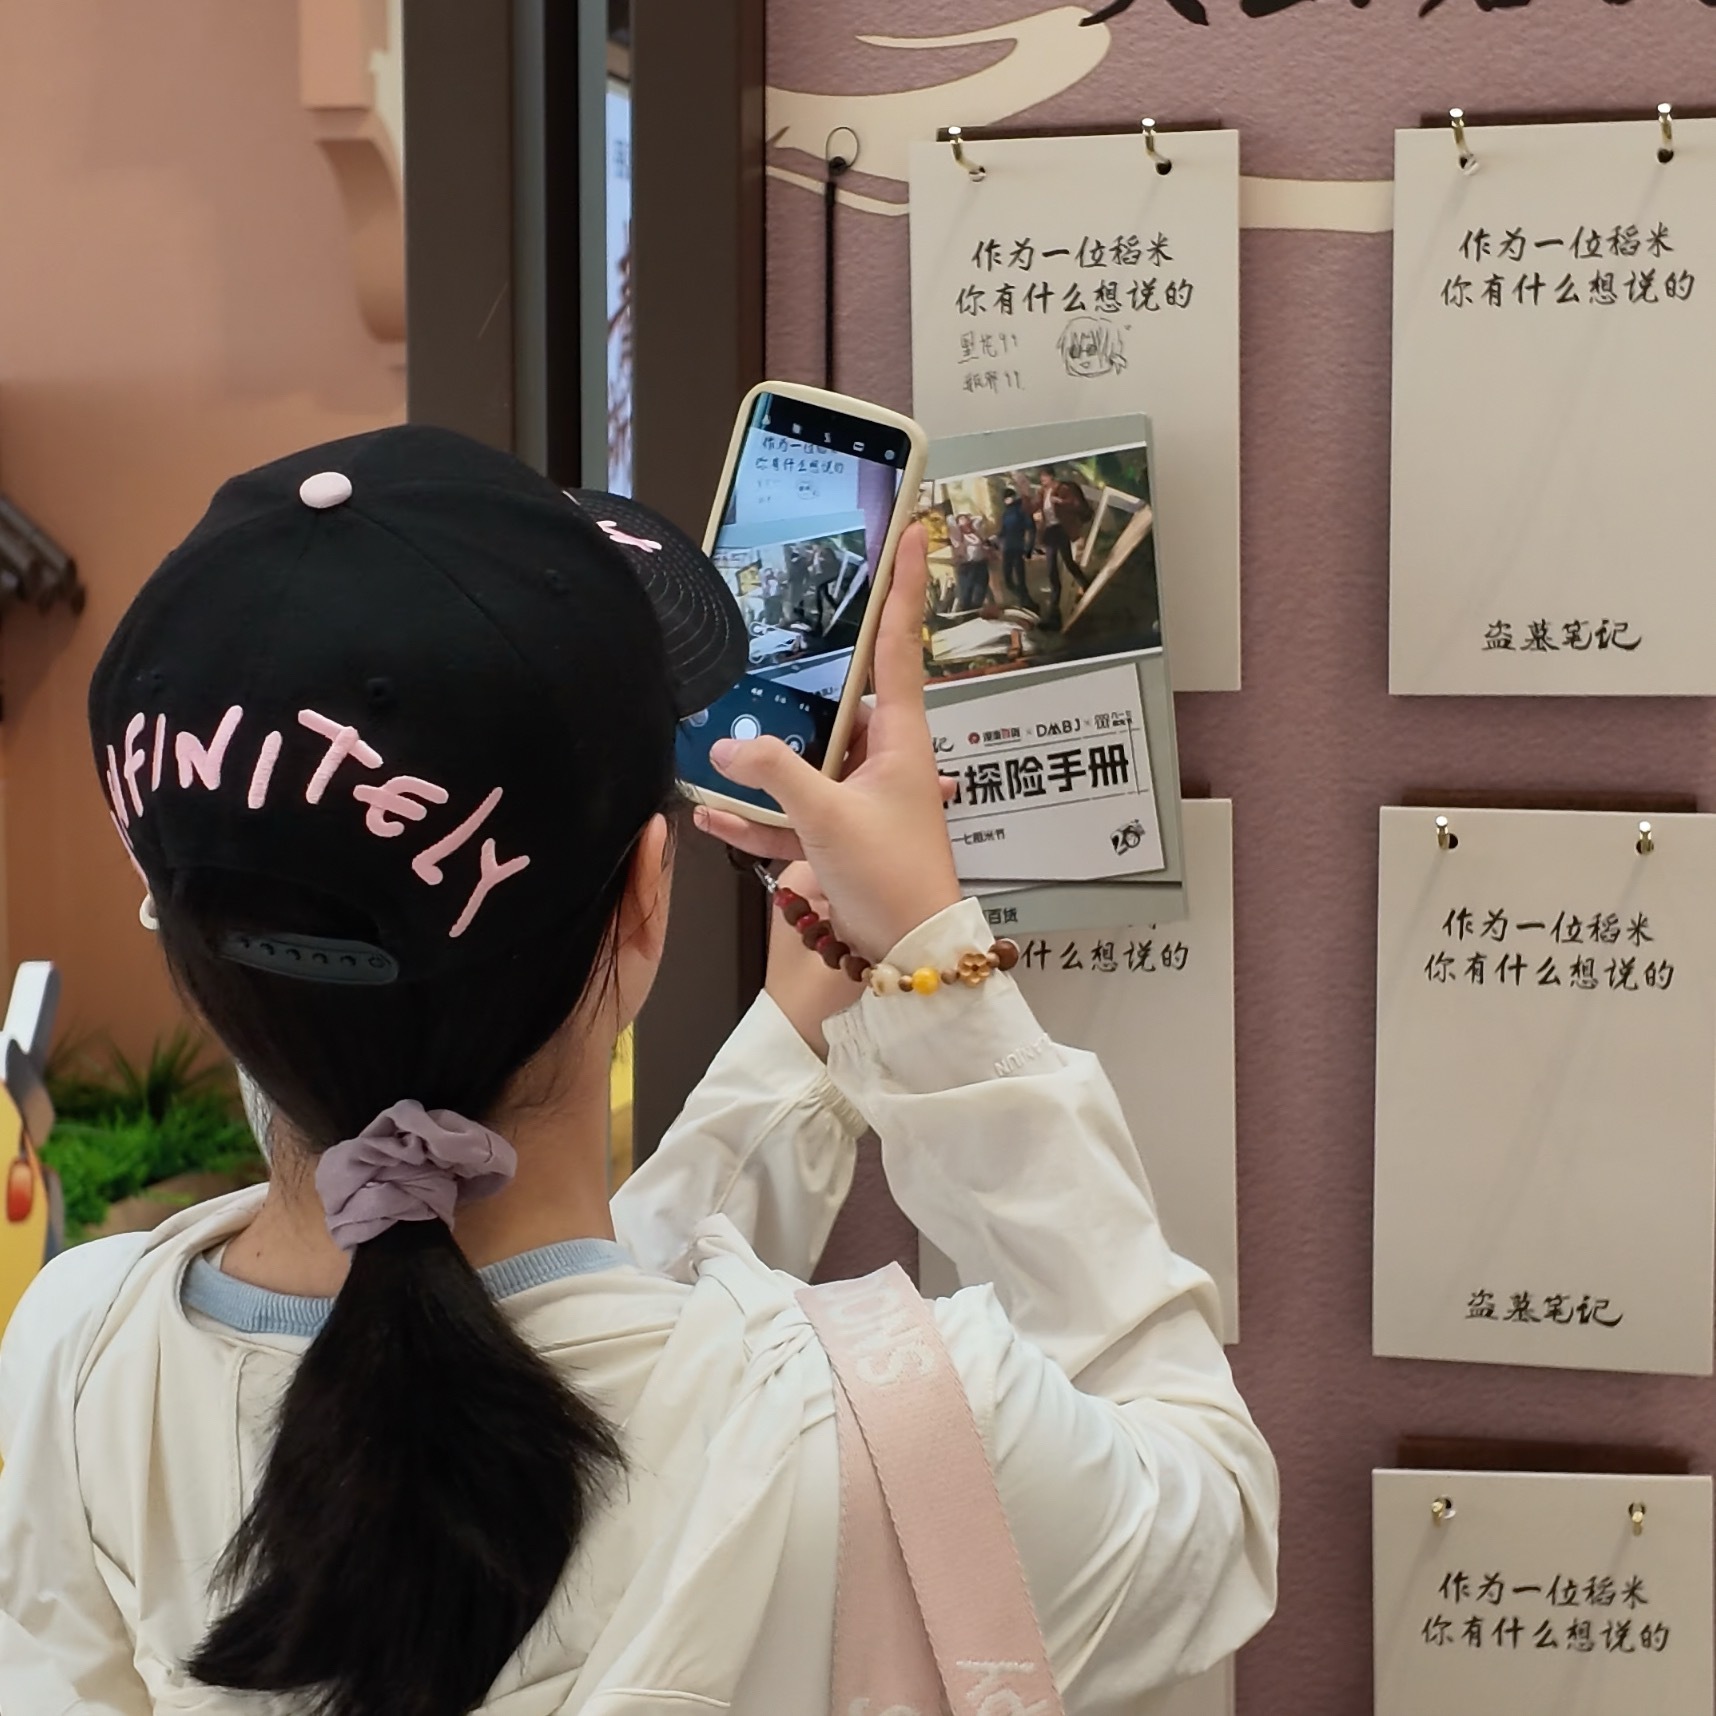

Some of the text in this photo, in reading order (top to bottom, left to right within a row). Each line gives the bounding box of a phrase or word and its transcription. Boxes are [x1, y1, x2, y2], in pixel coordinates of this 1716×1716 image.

[972, 231, 1173, 272] 作为一位稻米
[1459, 222, 1674, 262] 作为一位稻米
[955, 277, 1194, 316] 你有什么想说的
[1440, 269, 1695, 308] 你有什么想说的
[1481, 618, 1642, 652] 盗墓笔记
[1036, 718, 1081, 738] DMBJ
[1441, 907, 1654, 947] 作为一位稻米
[1424, 951, 1674, 991] 你有什么想说的
[1465, 1289, 1624, 1327] 盗墓笔记
[1438, 1571, 1649, 1610] 作为一位稻米
[1421, 1615, 1670, 1652] 你有什么想说的
